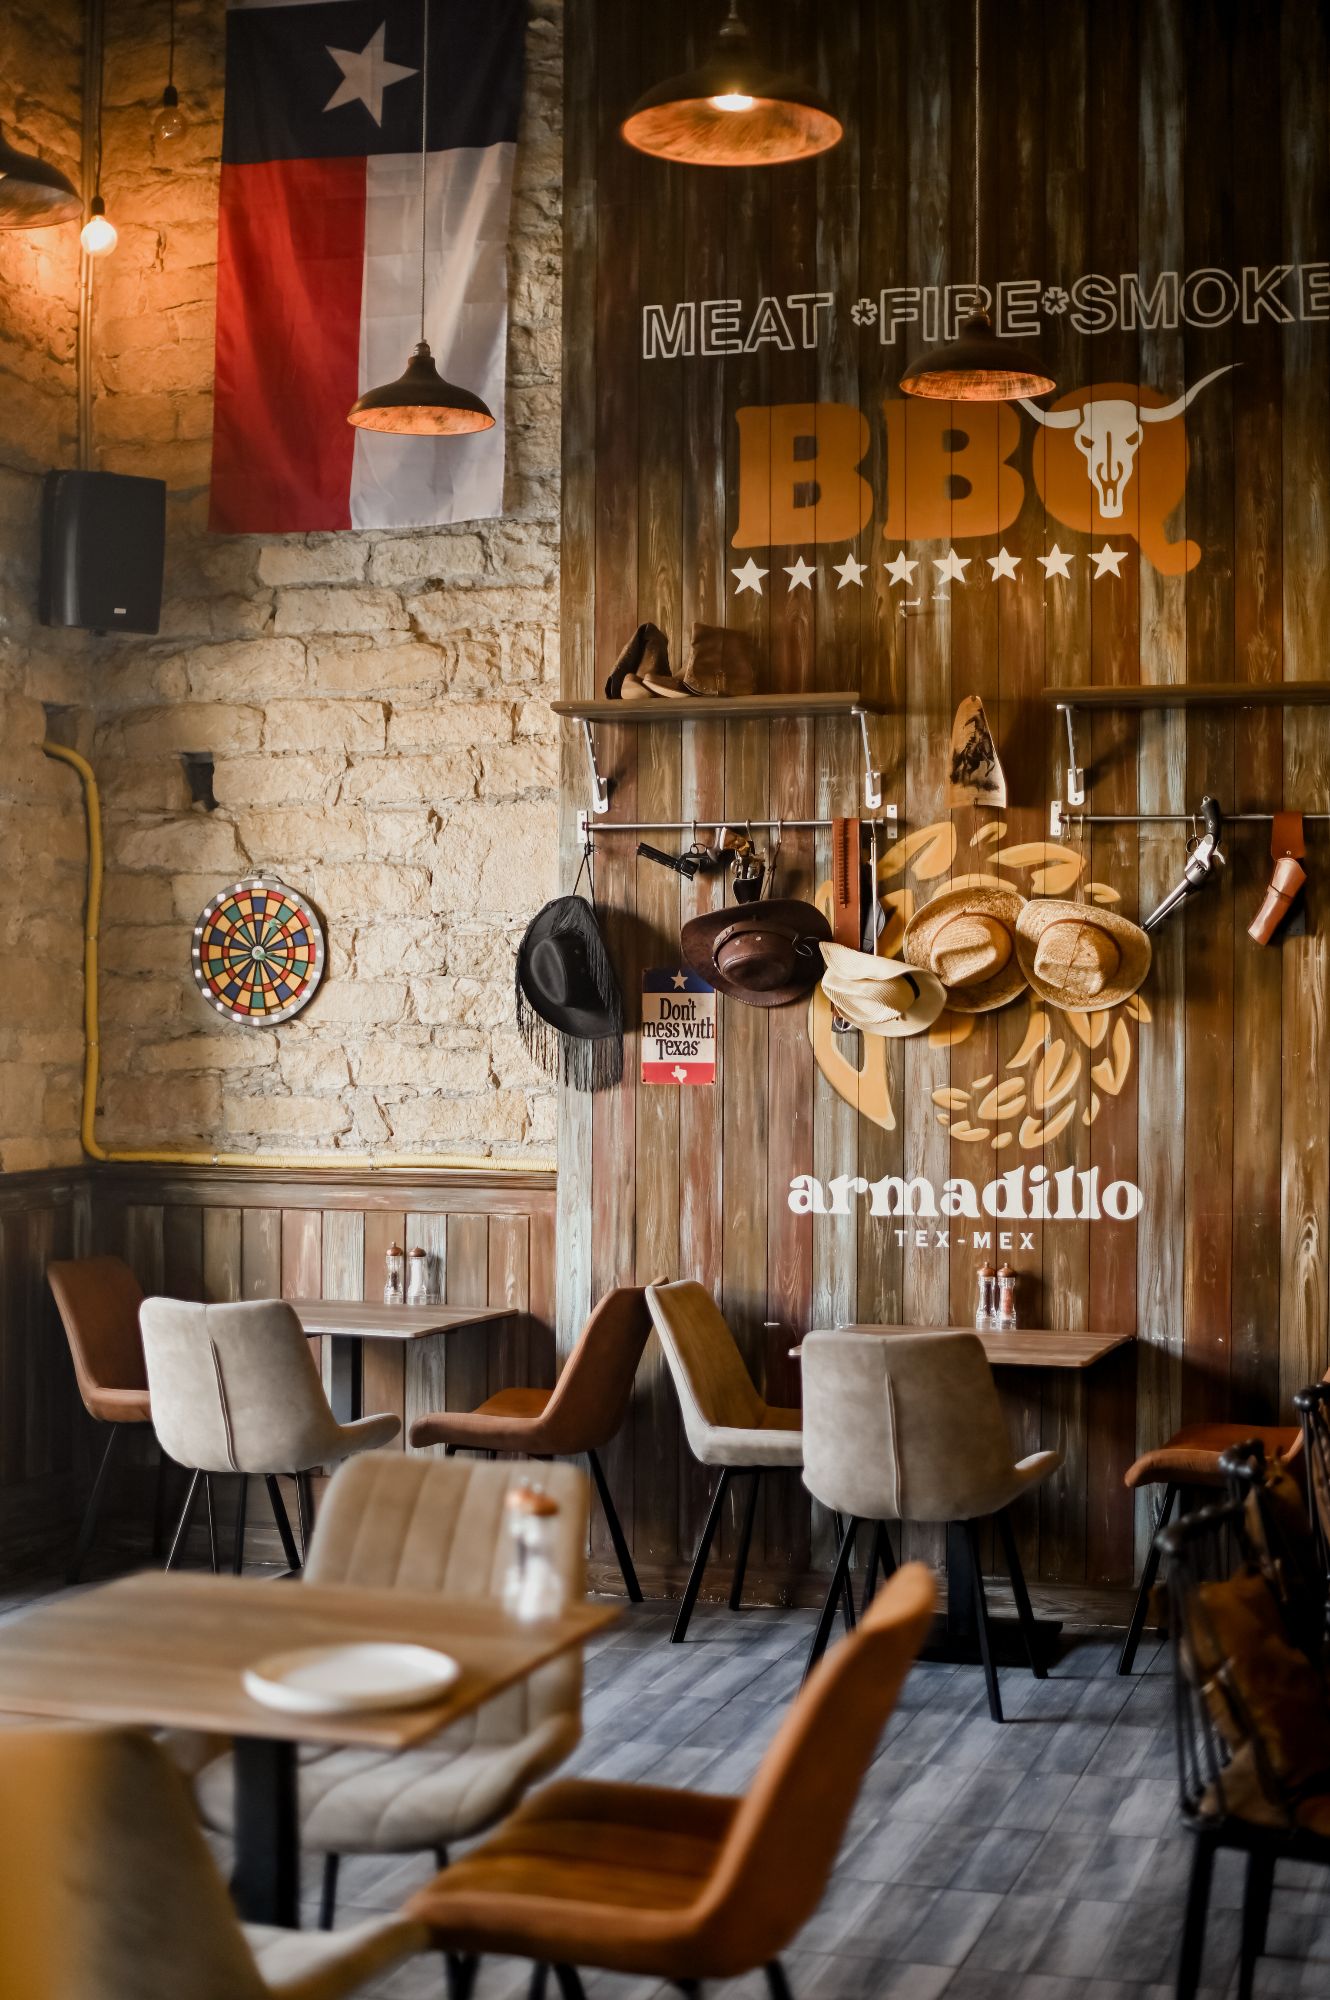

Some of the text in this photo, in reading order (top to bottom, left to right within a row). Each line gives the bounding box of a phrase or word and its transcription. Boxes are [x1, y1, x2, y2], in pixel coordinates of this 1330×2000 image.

[642, 293, 833, 359] MEAT
[1070, 262, 1330, 335] SMOKE
[731, 382, 1202, 577] BBQ
[659, 998, 696, 1021] Don't
[643, 1017, 714, 1039] mess with
[656, 1039, 700, 1060] Texas
[788, 1165, 1144, 1220] armadillo
[894, 1229, 1035, 1250] TEX-MEX
